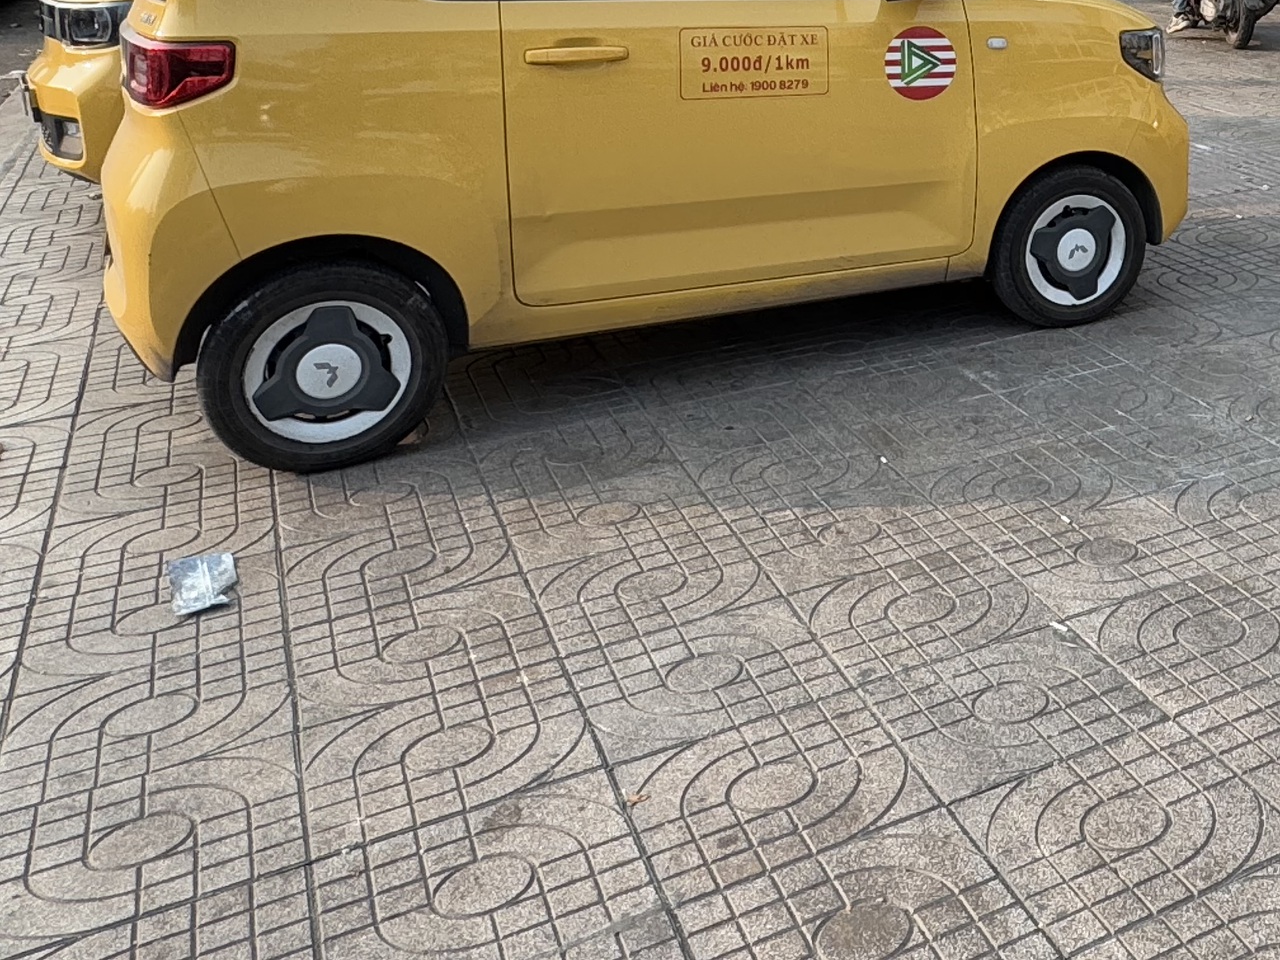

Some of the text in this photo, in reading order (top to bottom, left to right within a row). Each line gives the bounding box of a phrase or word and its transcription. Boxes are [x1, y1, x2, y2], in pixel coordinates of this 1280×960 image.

[690, 32, 819, 49] GIÁ CƯỚC ĐẶT XE
[701, 54, 810, 74] 9.000đ/1km
[702, 82, 728, 93] Liên
[750, 80, 777, 91] 1900
[779, 79, 809, 90] 8279
